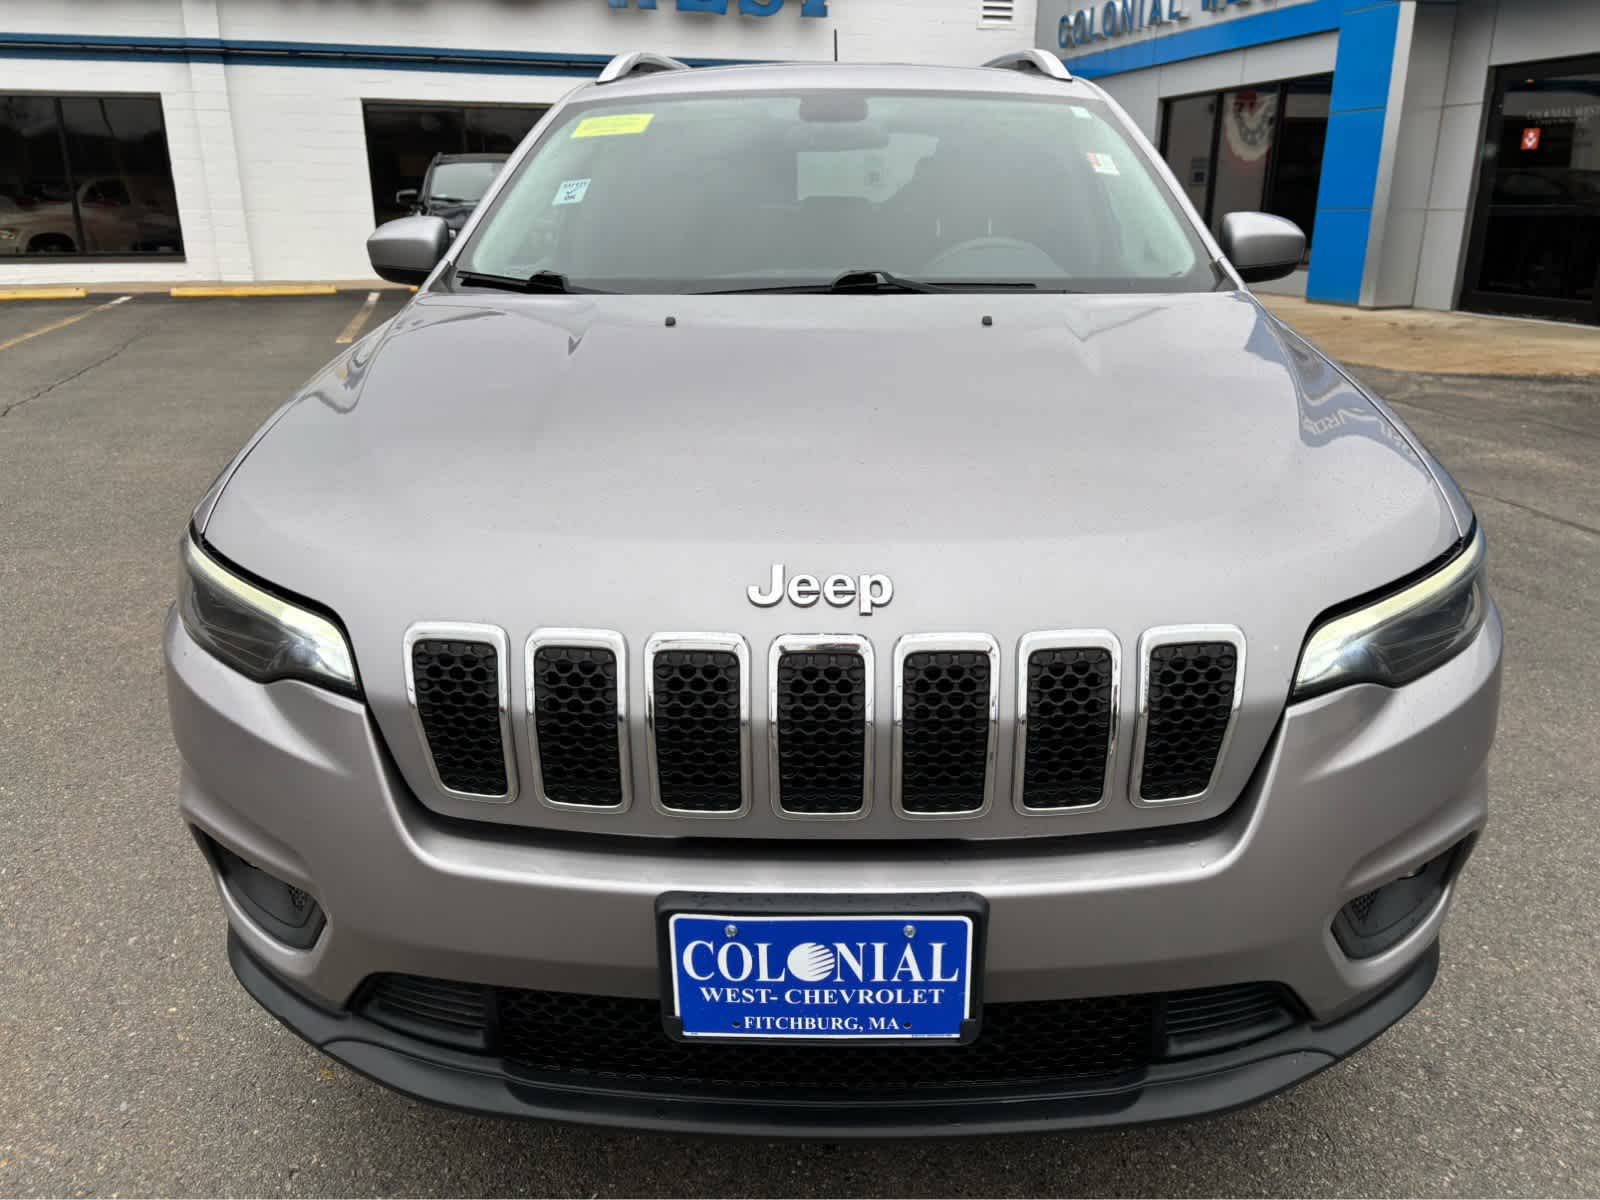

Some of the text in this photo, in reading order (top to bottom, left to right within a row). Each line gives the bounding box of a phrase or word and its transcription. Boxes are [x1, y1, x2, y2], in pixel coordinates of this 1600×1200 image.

[747, 563, 894, 616] Jeep
[682, 940, 960, 983] COLONIAL
[784, 988, 945, 1005] CHEVROLET
[743, 1016, 900, 1032] FITCHBURG, MA
